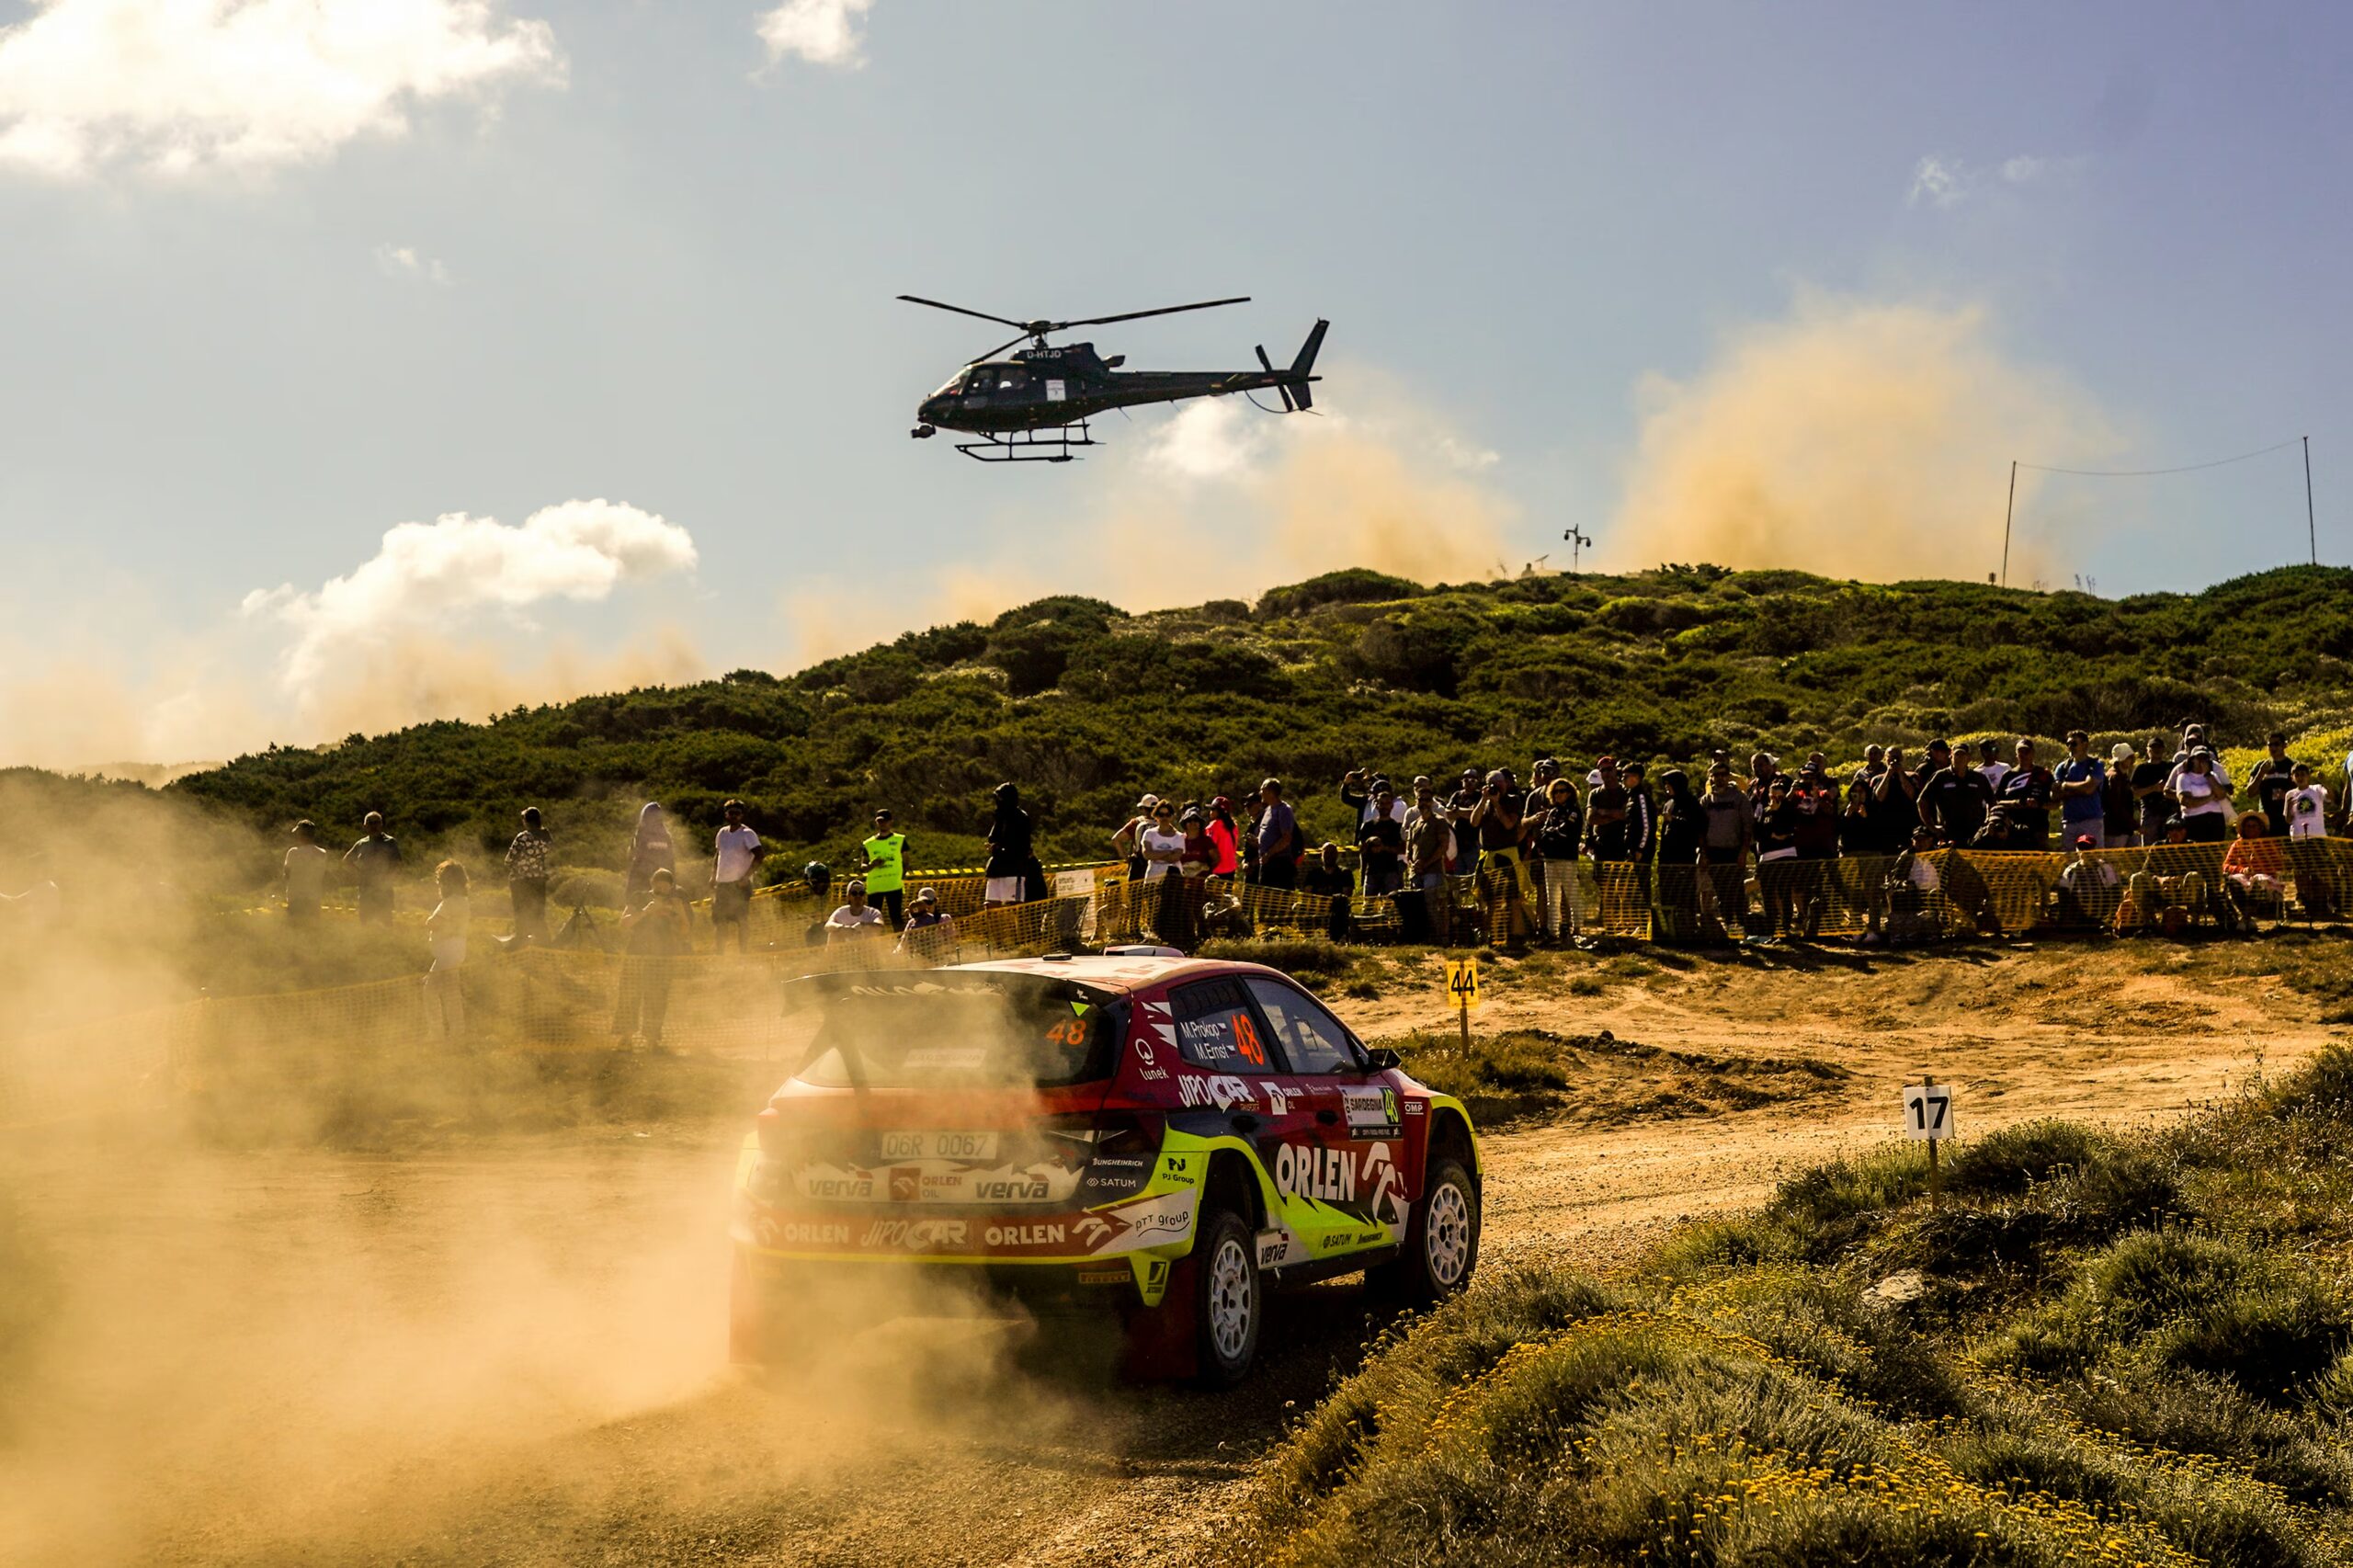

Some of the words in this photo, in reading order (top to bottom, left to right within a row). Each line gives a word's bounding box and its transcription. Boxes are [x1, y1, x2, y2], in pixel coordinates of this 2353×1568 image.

[1451, 970, 1475, 997] 44
[1045, 1019, 1086, 1045] 48
[1232, 1014, 1264, 1065] 48
[1383, 1088, 1399, 1123] 48
[1404, 1104, 1424, 1112] OMP
[1909, 1096, 1949, 1130] 17
[922, 1176, 962, 1187] ORLEN
[1100, 1177, 1136, 1188] SATUM
[1173, 1174, 1195, 1185] Group
[1276, 1142, 1357, 1202] ORLEN
[809, 1179, 873, 1198] verva
[922, 1188, 939, 1199] OIL
[975, 1181, 1049, 1199] verva
[784, 1221, 849, 1244] ORLEN
[985, 1223, 1065, 1246] ORLEN
[1261, 1243, 1288, 1265] verva
